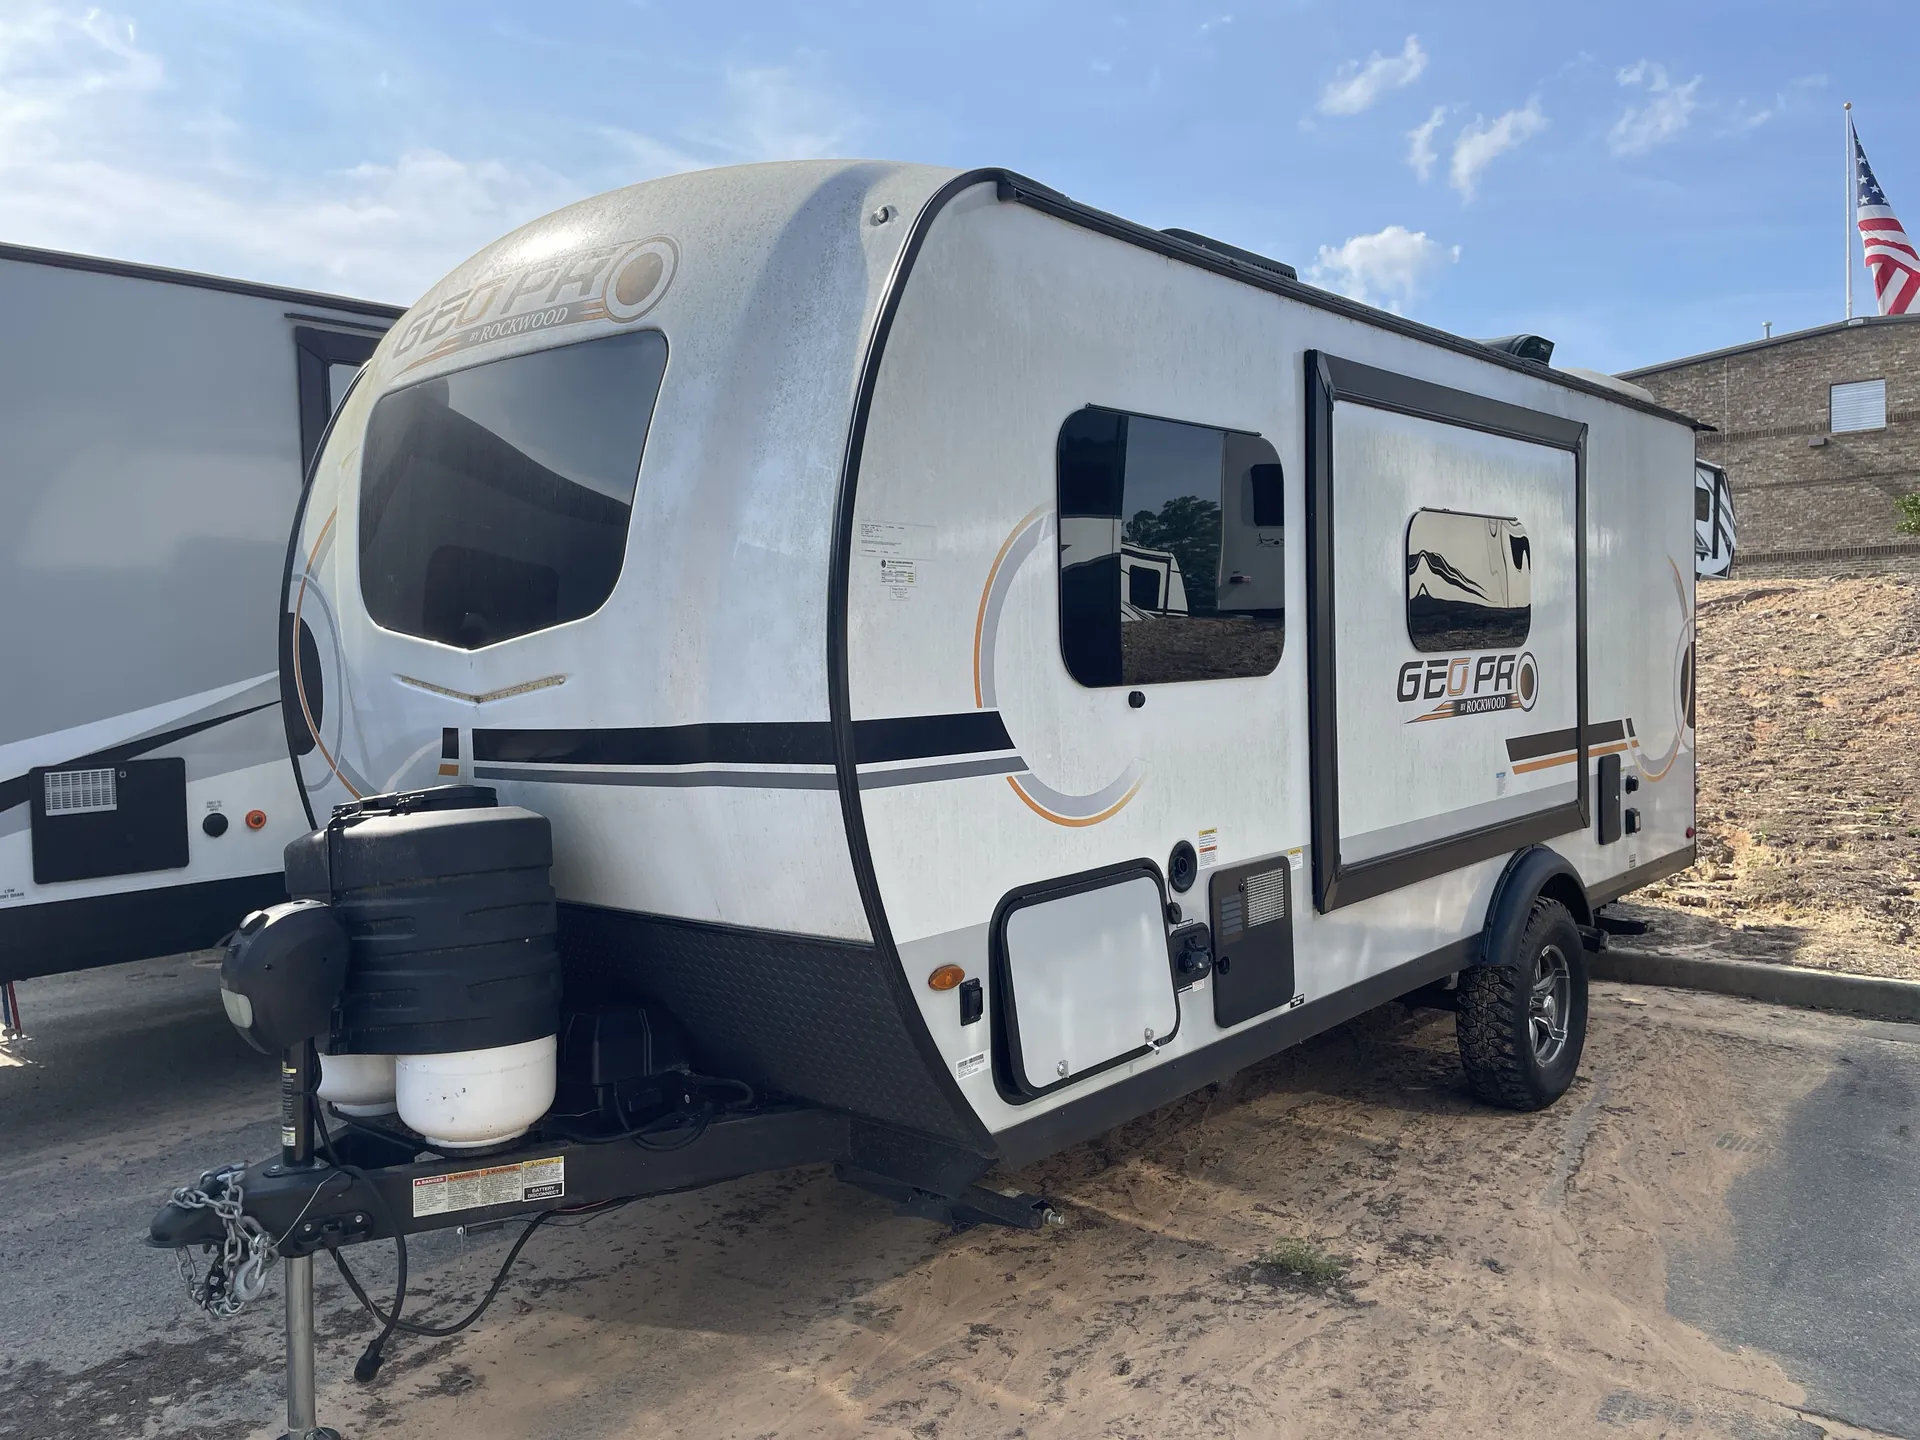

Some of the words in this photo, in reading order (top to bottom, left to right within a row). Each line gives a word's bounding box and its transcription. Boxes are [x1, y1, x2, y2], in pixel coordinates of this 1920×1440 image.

[393, 272, 513, 359] GEO
[500, 236, 680, 324] PRO
[469, 332, 480, 342] BY
[479, 307, 569, 342] ROCKWOOD
[1397, 657, 1471, 702] GEO
[1473, 651, 1539, 712] PRO
[1460, 703, 1466, 711] BY
[1466, 697, 1506, 713] ROCKWOOD
[527, 1189, 559, 1198] DISCONNECT
[532, 1185, 555, 1193] BATTERY
